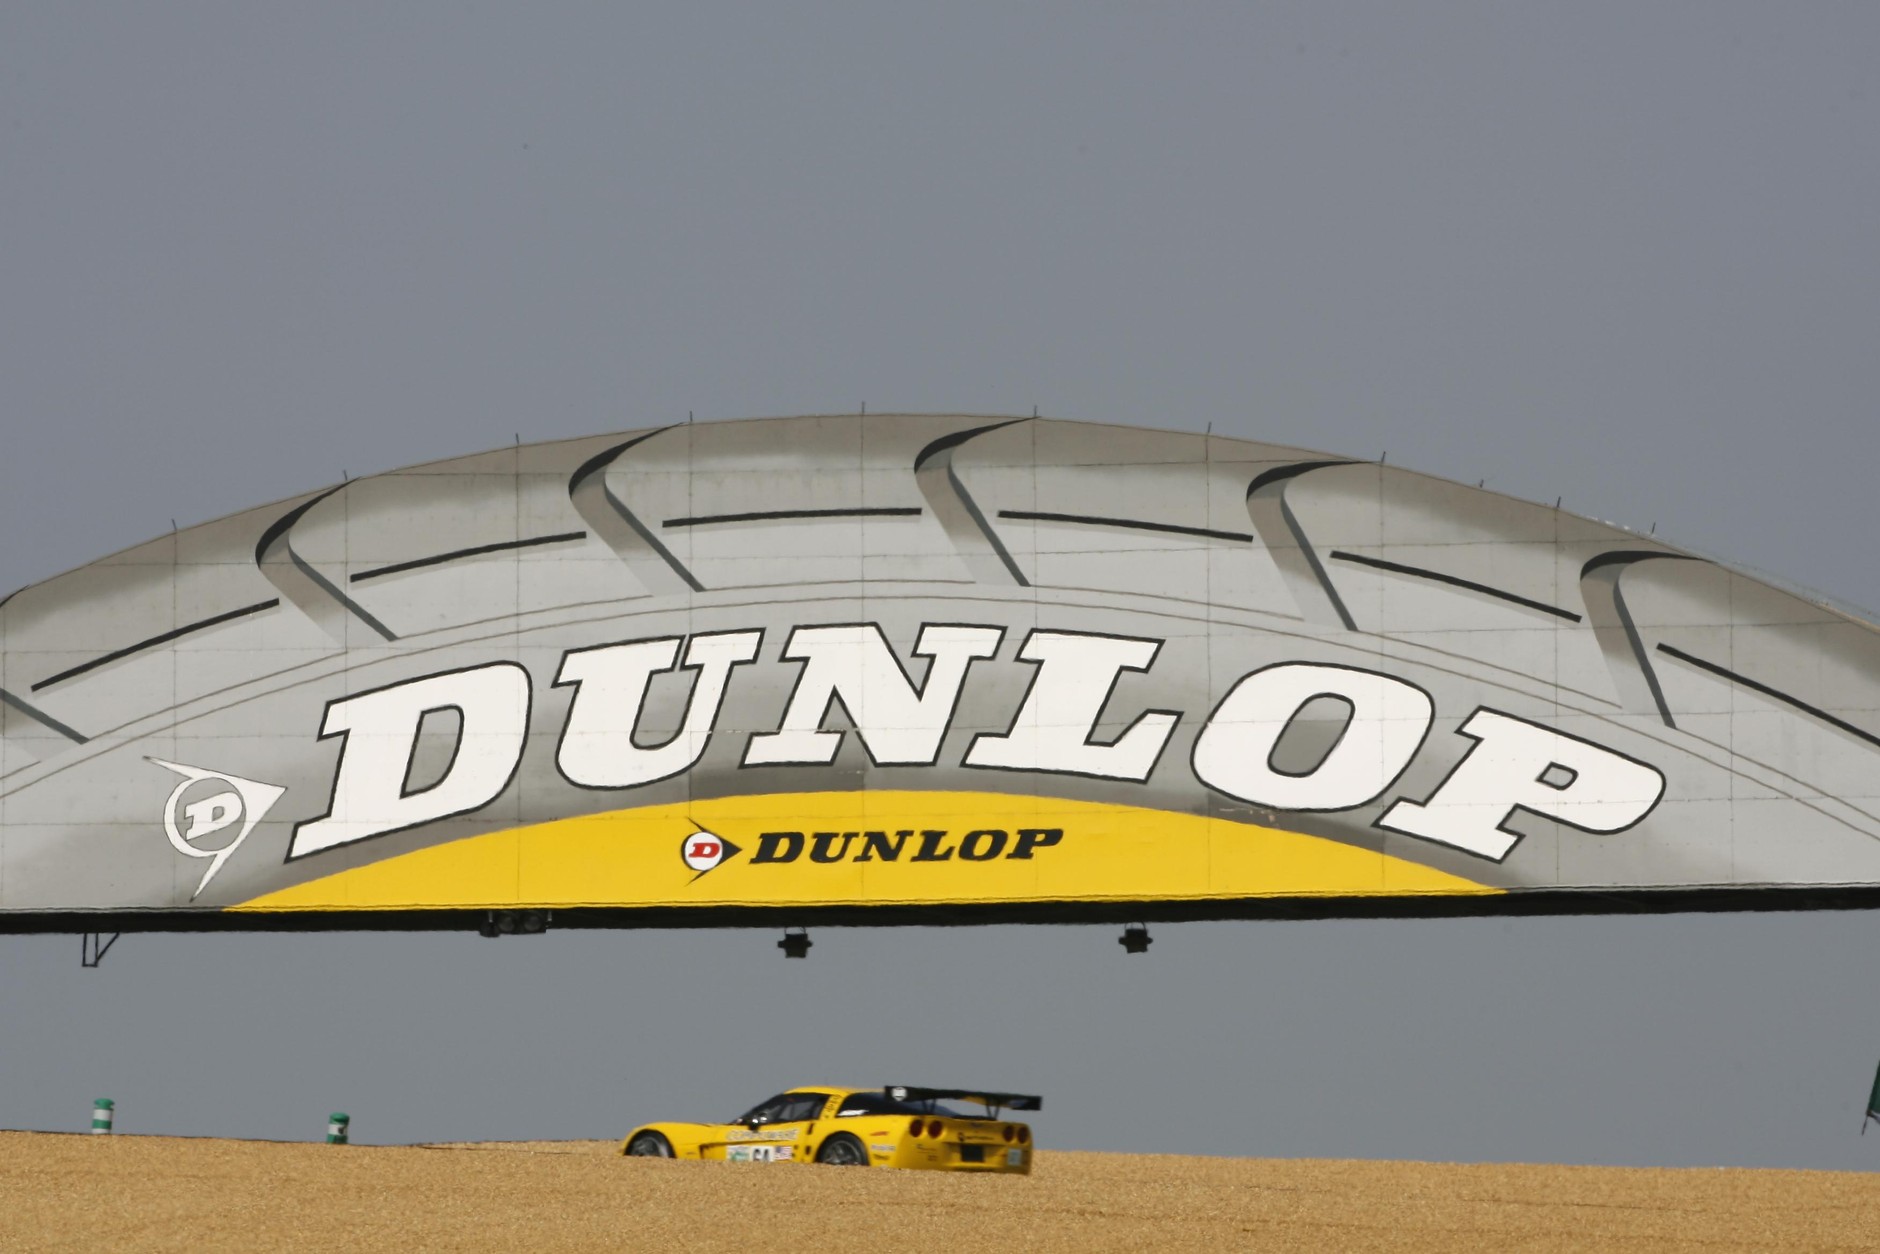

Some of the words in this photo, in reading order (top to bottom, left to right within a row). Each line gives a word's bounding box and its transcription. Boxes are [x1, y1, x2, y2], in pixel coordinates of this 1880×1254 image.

[283, 621, 1667, 864] DUNLOP
[183, 791, 245, 841] D
[688, 842, 720, 858] D
[749, 828, 1065, 865] DUNLOP
